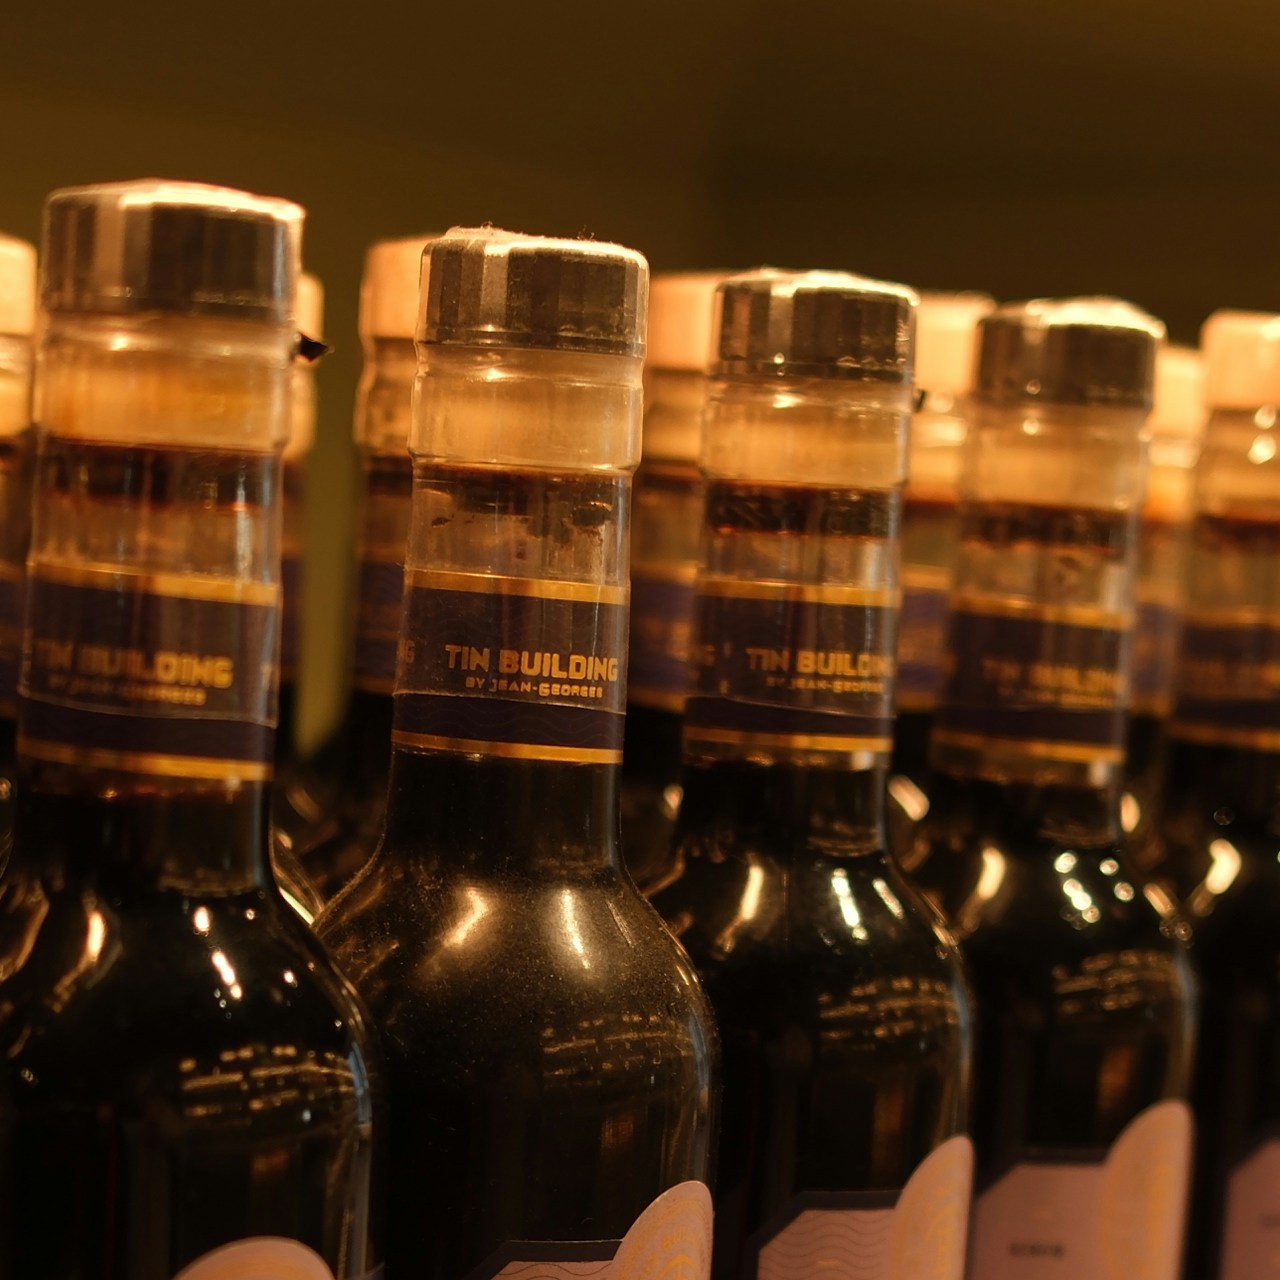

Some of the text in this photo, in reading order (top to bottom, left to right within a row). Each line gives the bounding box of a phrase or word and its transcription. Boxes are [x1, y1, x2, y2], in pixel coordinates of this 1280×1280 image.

[78, 644, 235, 690] BUILDING
[445, 644, 491, 673] TIN
[498, 649, 619, 682] BUILDING
[745, 647, 791, 674] TIN
[465, 676, 604, 699] BY JEAN-GEORGES
